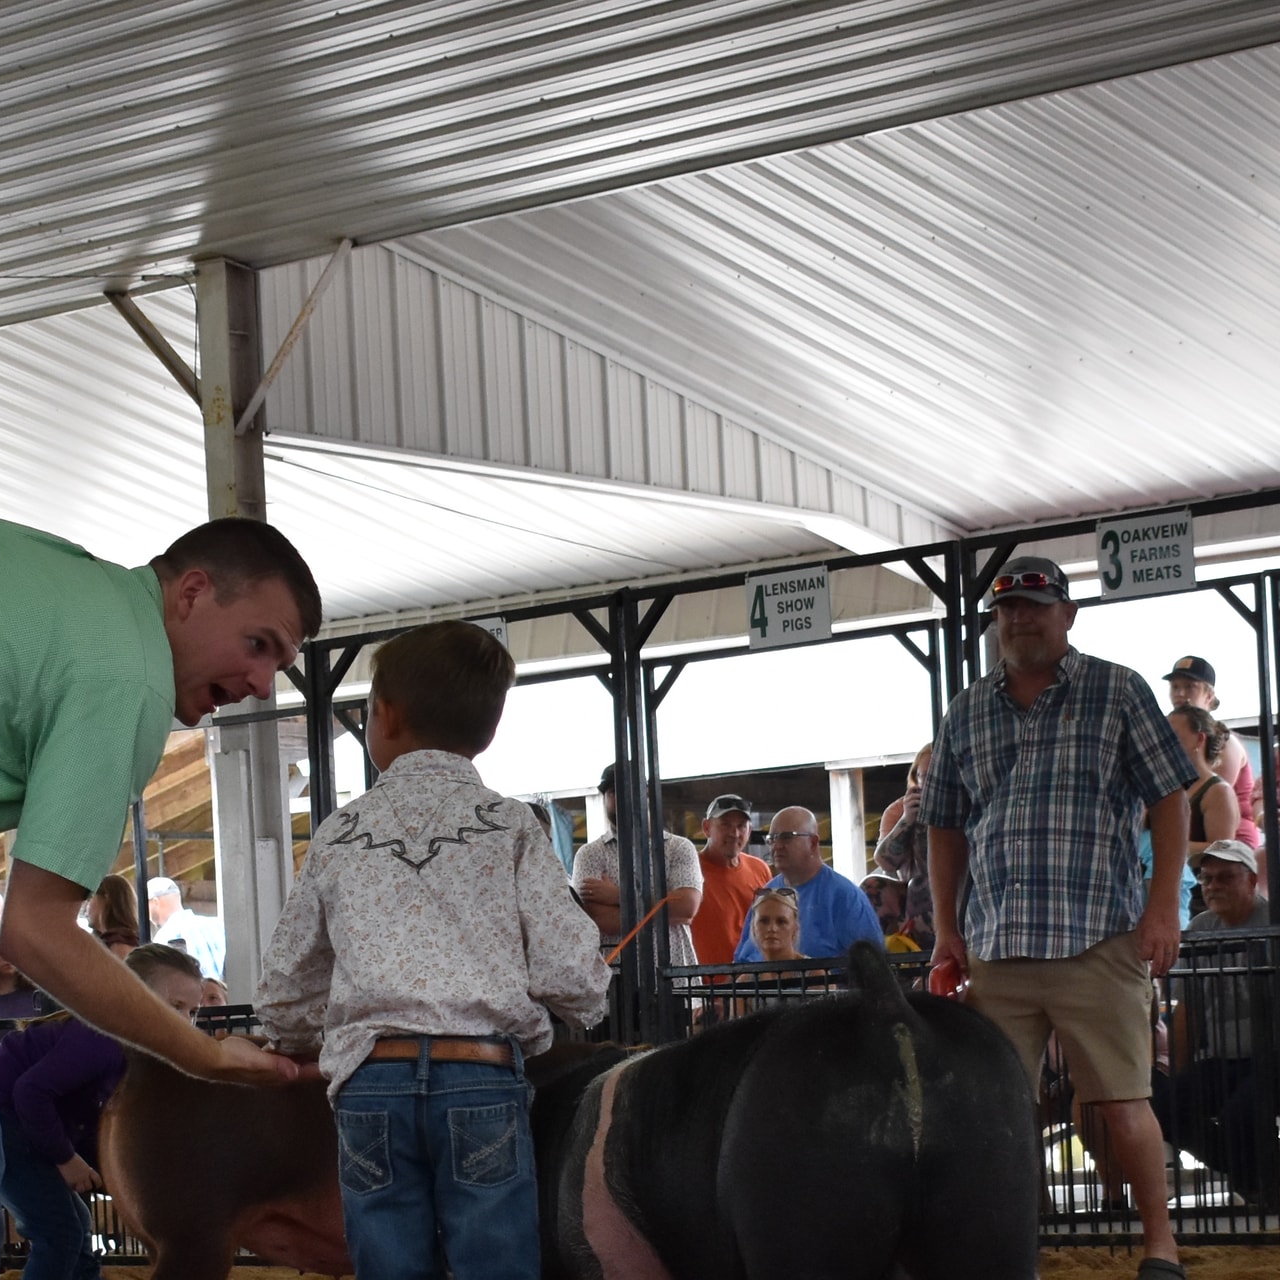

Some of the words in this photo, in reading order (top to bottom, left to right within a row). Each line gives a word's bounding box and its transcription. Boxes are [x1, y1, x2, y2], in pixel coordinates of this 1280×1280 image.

[1121, 522, 1188, 544] OAKVEIW
[1101, 529, 1123, 590] 3
[1130, 544, 1181, 563] FARMS
[1132, 564, 1182, 584] MEATS
[764, 575, 825, 597] LENSMAN
[750, 584, 768, 638] 4
[777, 596, 815, 614] SHOW
[782, 616, 812, 632] PIGS
